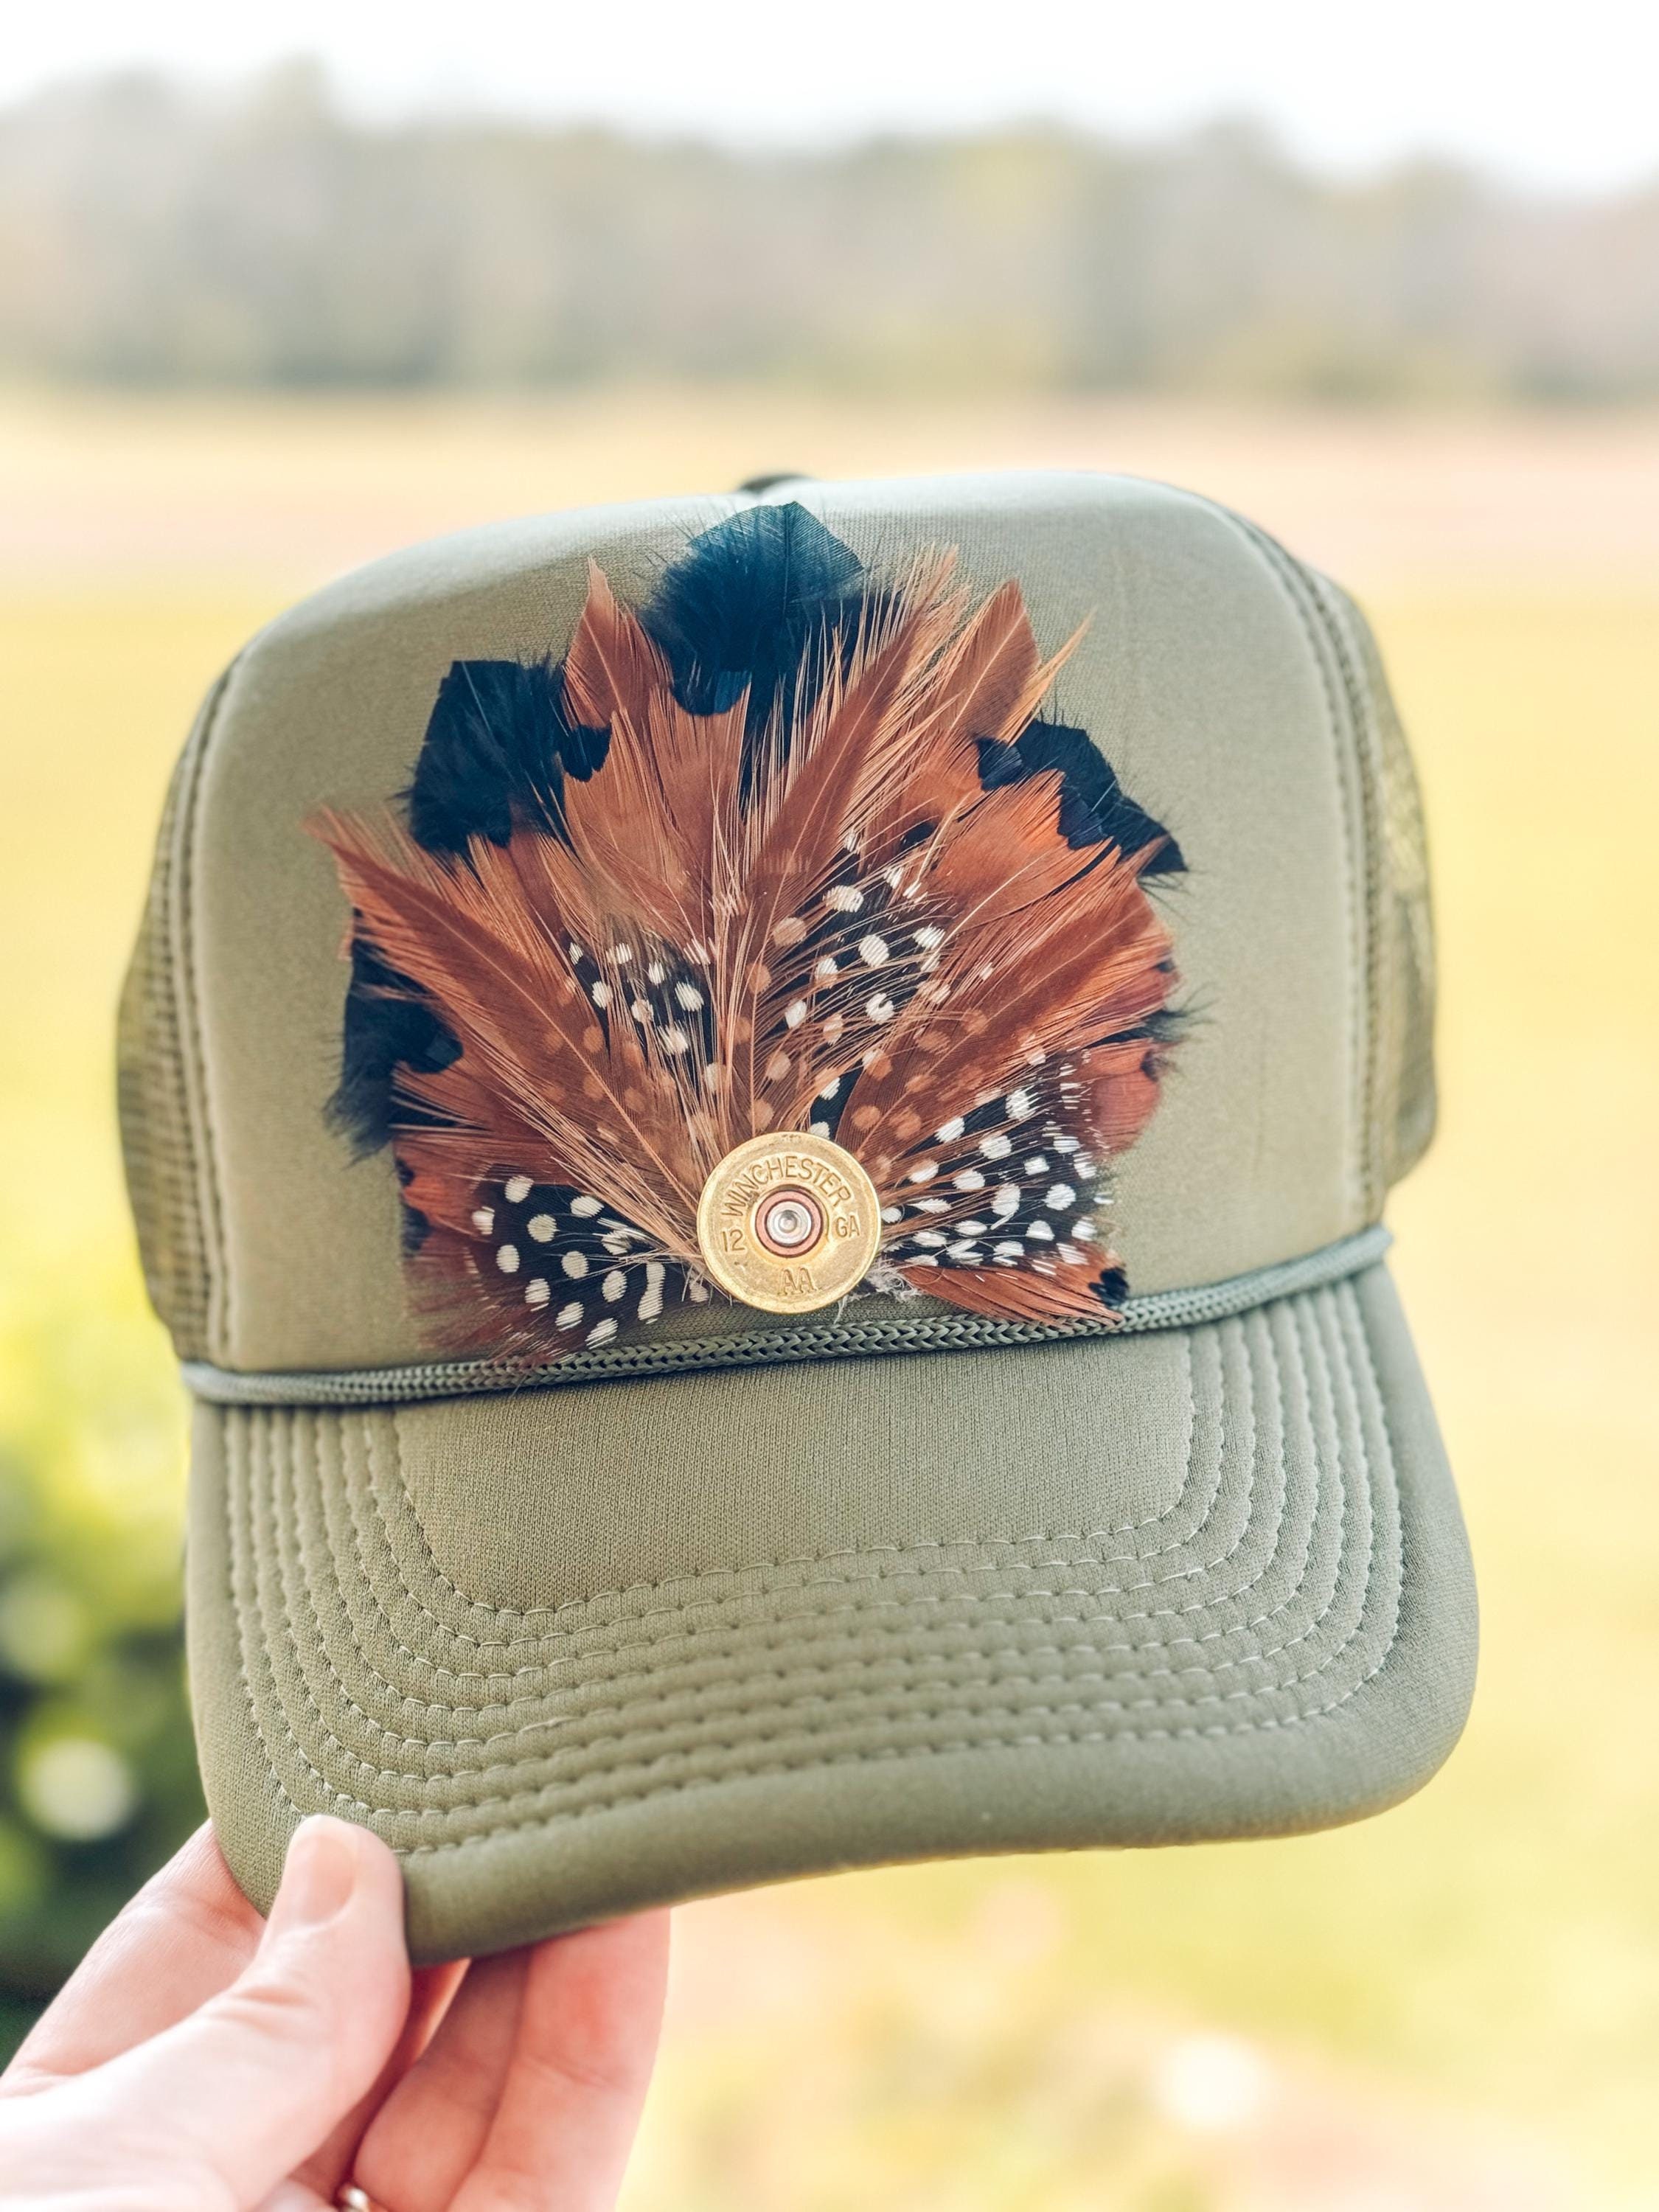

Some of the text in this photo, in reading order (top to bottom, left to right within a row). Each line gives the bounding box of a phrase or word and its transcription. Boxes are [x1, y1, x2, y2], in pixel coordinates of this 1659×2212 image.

[721, 1155, 852, 1217] WINCHESTER
[721, 1214, 860, 1253] 12 GA
[777, 1267, 818, 1295] AA
